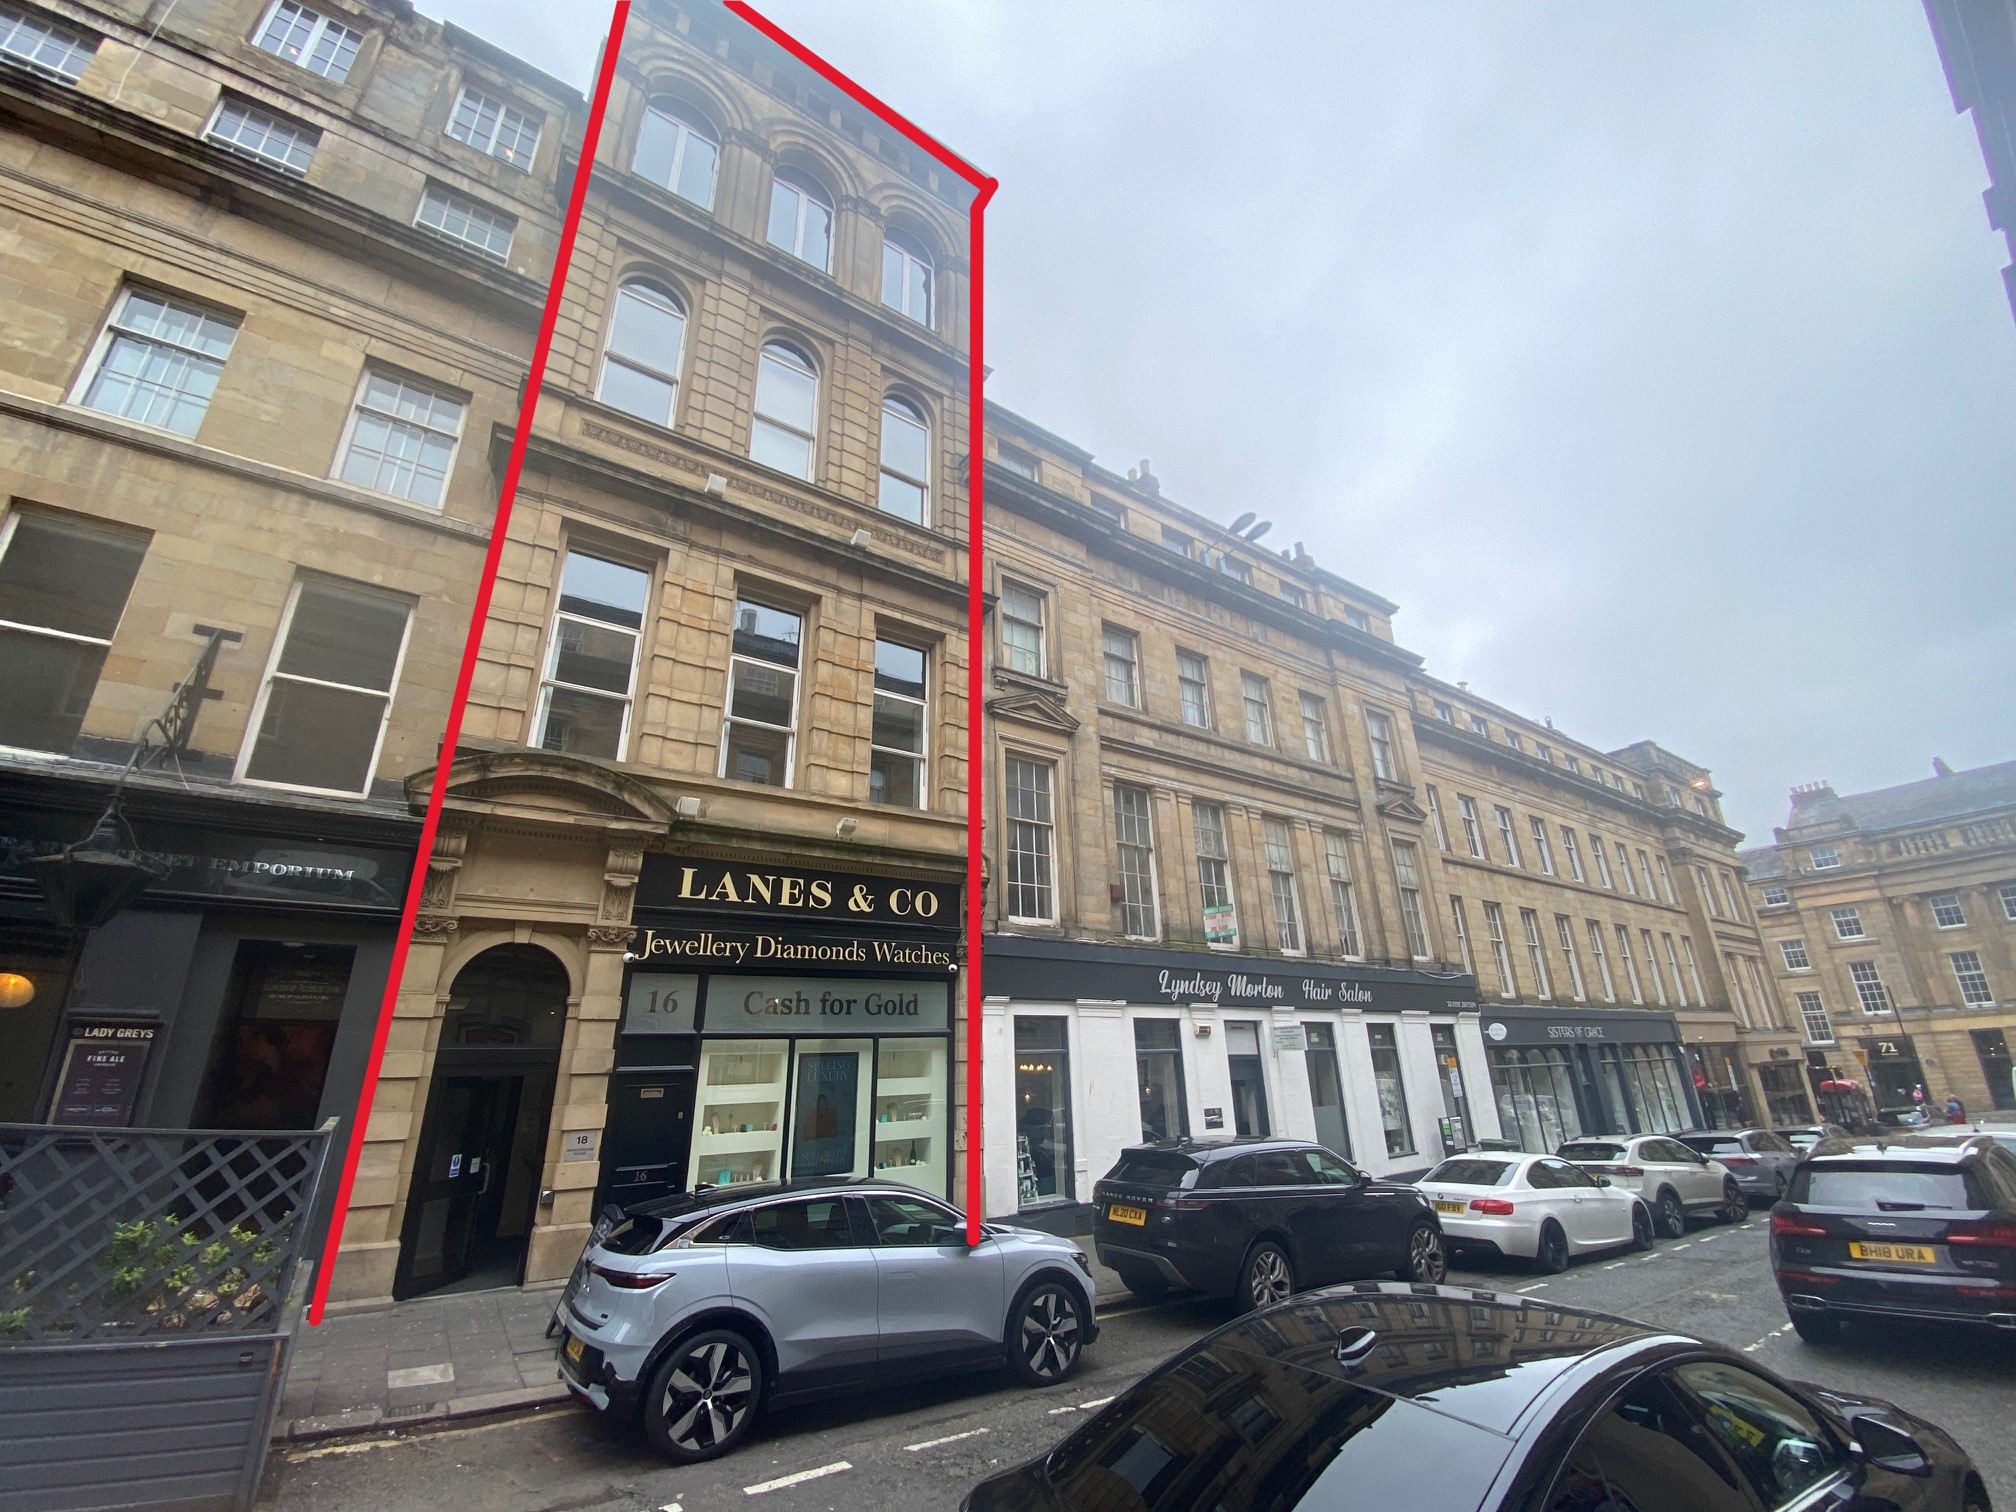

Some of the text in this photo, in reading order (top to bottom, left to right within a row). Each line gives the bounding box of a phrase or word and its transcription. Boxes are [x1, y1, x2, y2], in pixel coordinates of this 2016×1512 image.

[209, 856, 355, 882] EMPORIUM
[677, 866, 939, 917] LANES & CO
[634, 929, 950, 966] Jewellery Diamonds Watches
[1158, 969, 1373, 1004] Lyndsey Morton Hair Salon
[646, 989, 679, 1014] 16
[743, 990, 919, 1017] Cash for Gold
[84, 1027, 155, 1039] LADY GREYS
[1547, 1026, 1605, 1038] SISTERS OF GRACE
[1878, 1042, 1898, 1053] 71
[109, 1055, 126, 1063] ALE
[807, 1060, 850, 1072] SELLING
[577, 1135, 588, 1145] 18
[633, 1170, 648, 1183] 16
[1125, 1194, 1154, 1203] ROVER
[1128, 1208, 1143, 1221] CXA
[1860, 1244, 1927, 1262] BH18 URA
